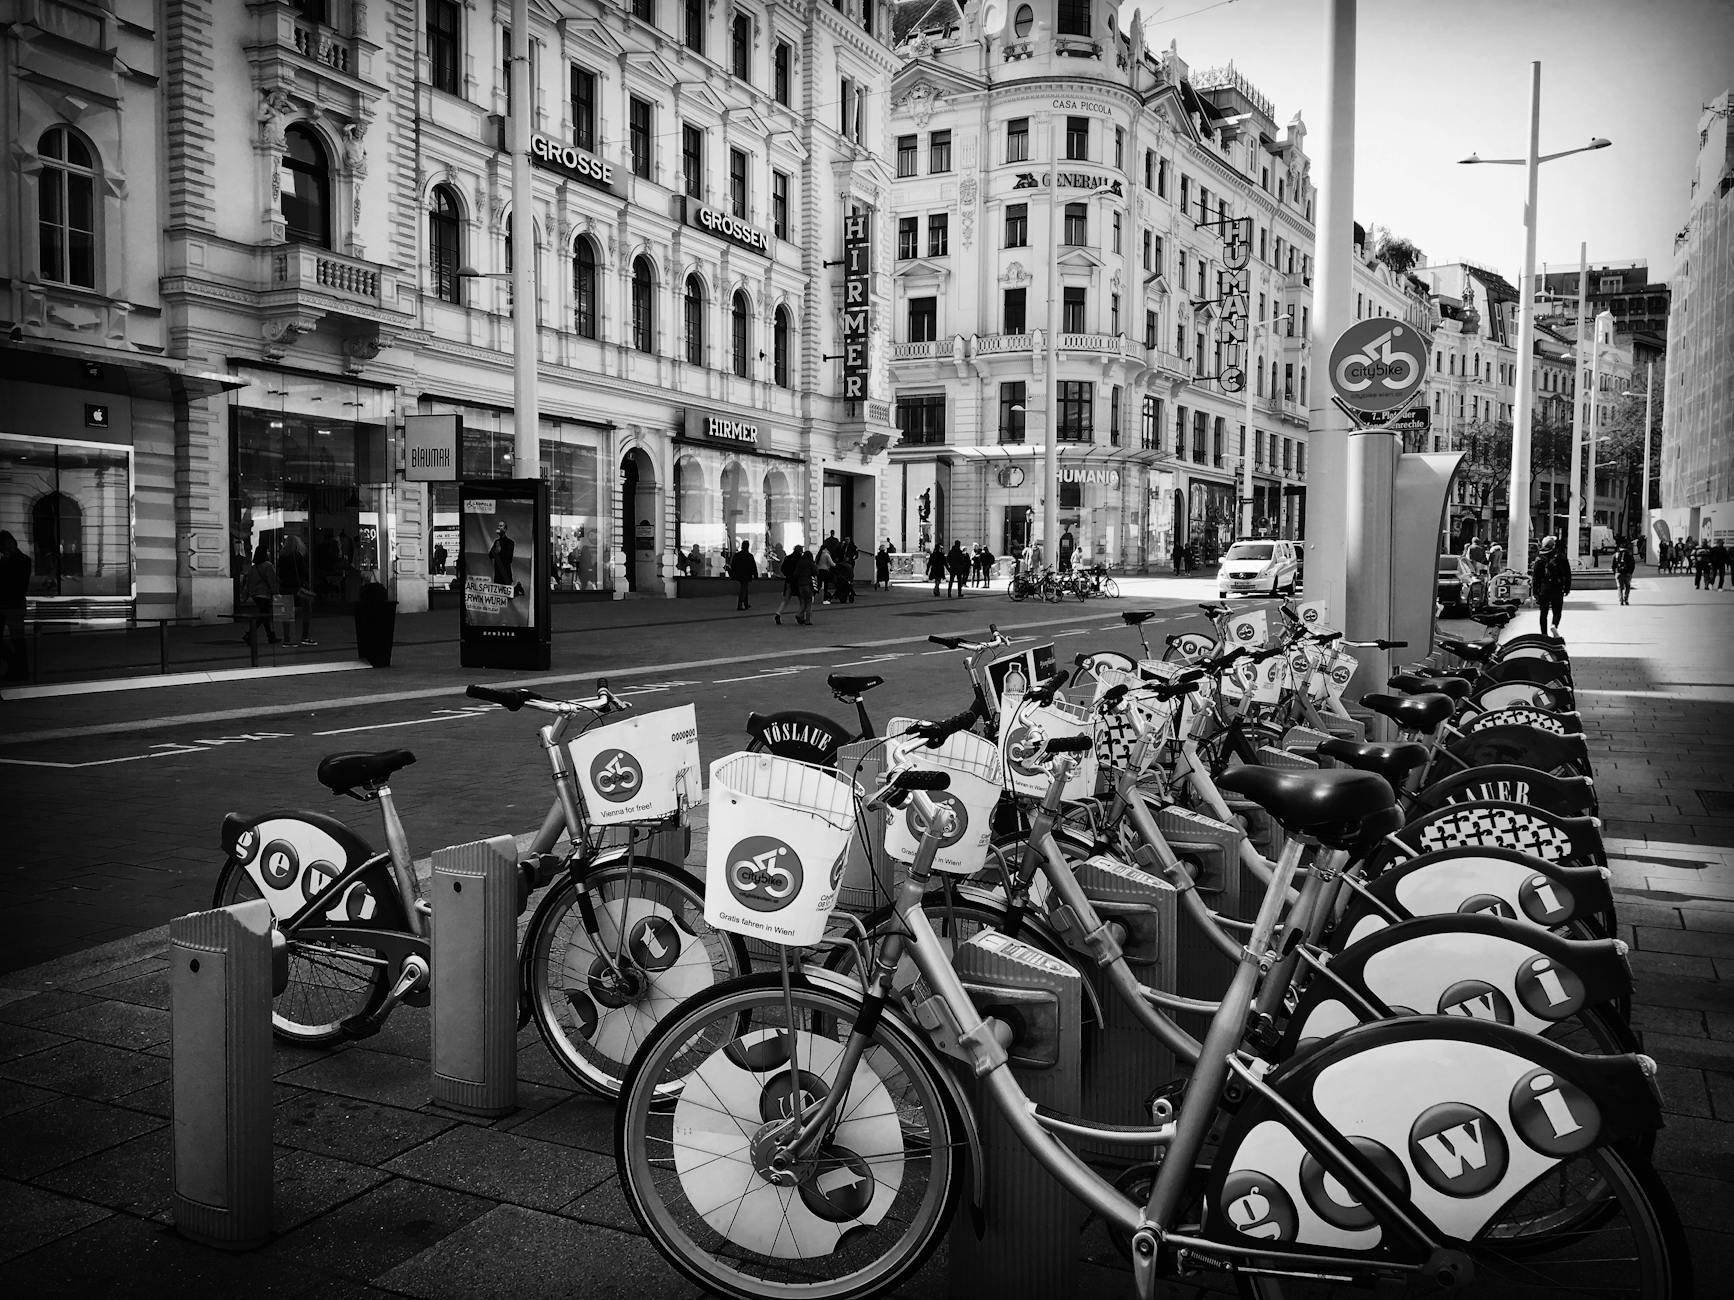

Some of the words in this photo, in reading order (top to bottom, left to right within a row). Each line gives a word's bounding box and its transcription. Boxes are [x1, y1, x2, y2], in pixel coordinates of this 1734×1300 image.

[1052, 100, 1078, 110] CASA
[1080, 101, 1113, 116] PICCOLA
[531, 133, 614, 186] GROSSE
[700, 206, 770, 251] GRÖSSEN
[844, 217, 866, 398] HIRMER
[1219, 218, 1251, 393] HUMANIC
[1351, 363, 1404, 379] citybike
[707, 416, 759, 443] HIRMER
[465, 582, 478, 591] ARL
[600, 809, 625, 818] Vienna
[636, 802, 652, 811] free!
[741, 871, 783, 887] citybike
[719, 911, 740, 924] Gratis
[741, 918, 764, 930] fahren
[766, 923, 773, 932] in
[774, 926, 795, 937] Wien!
